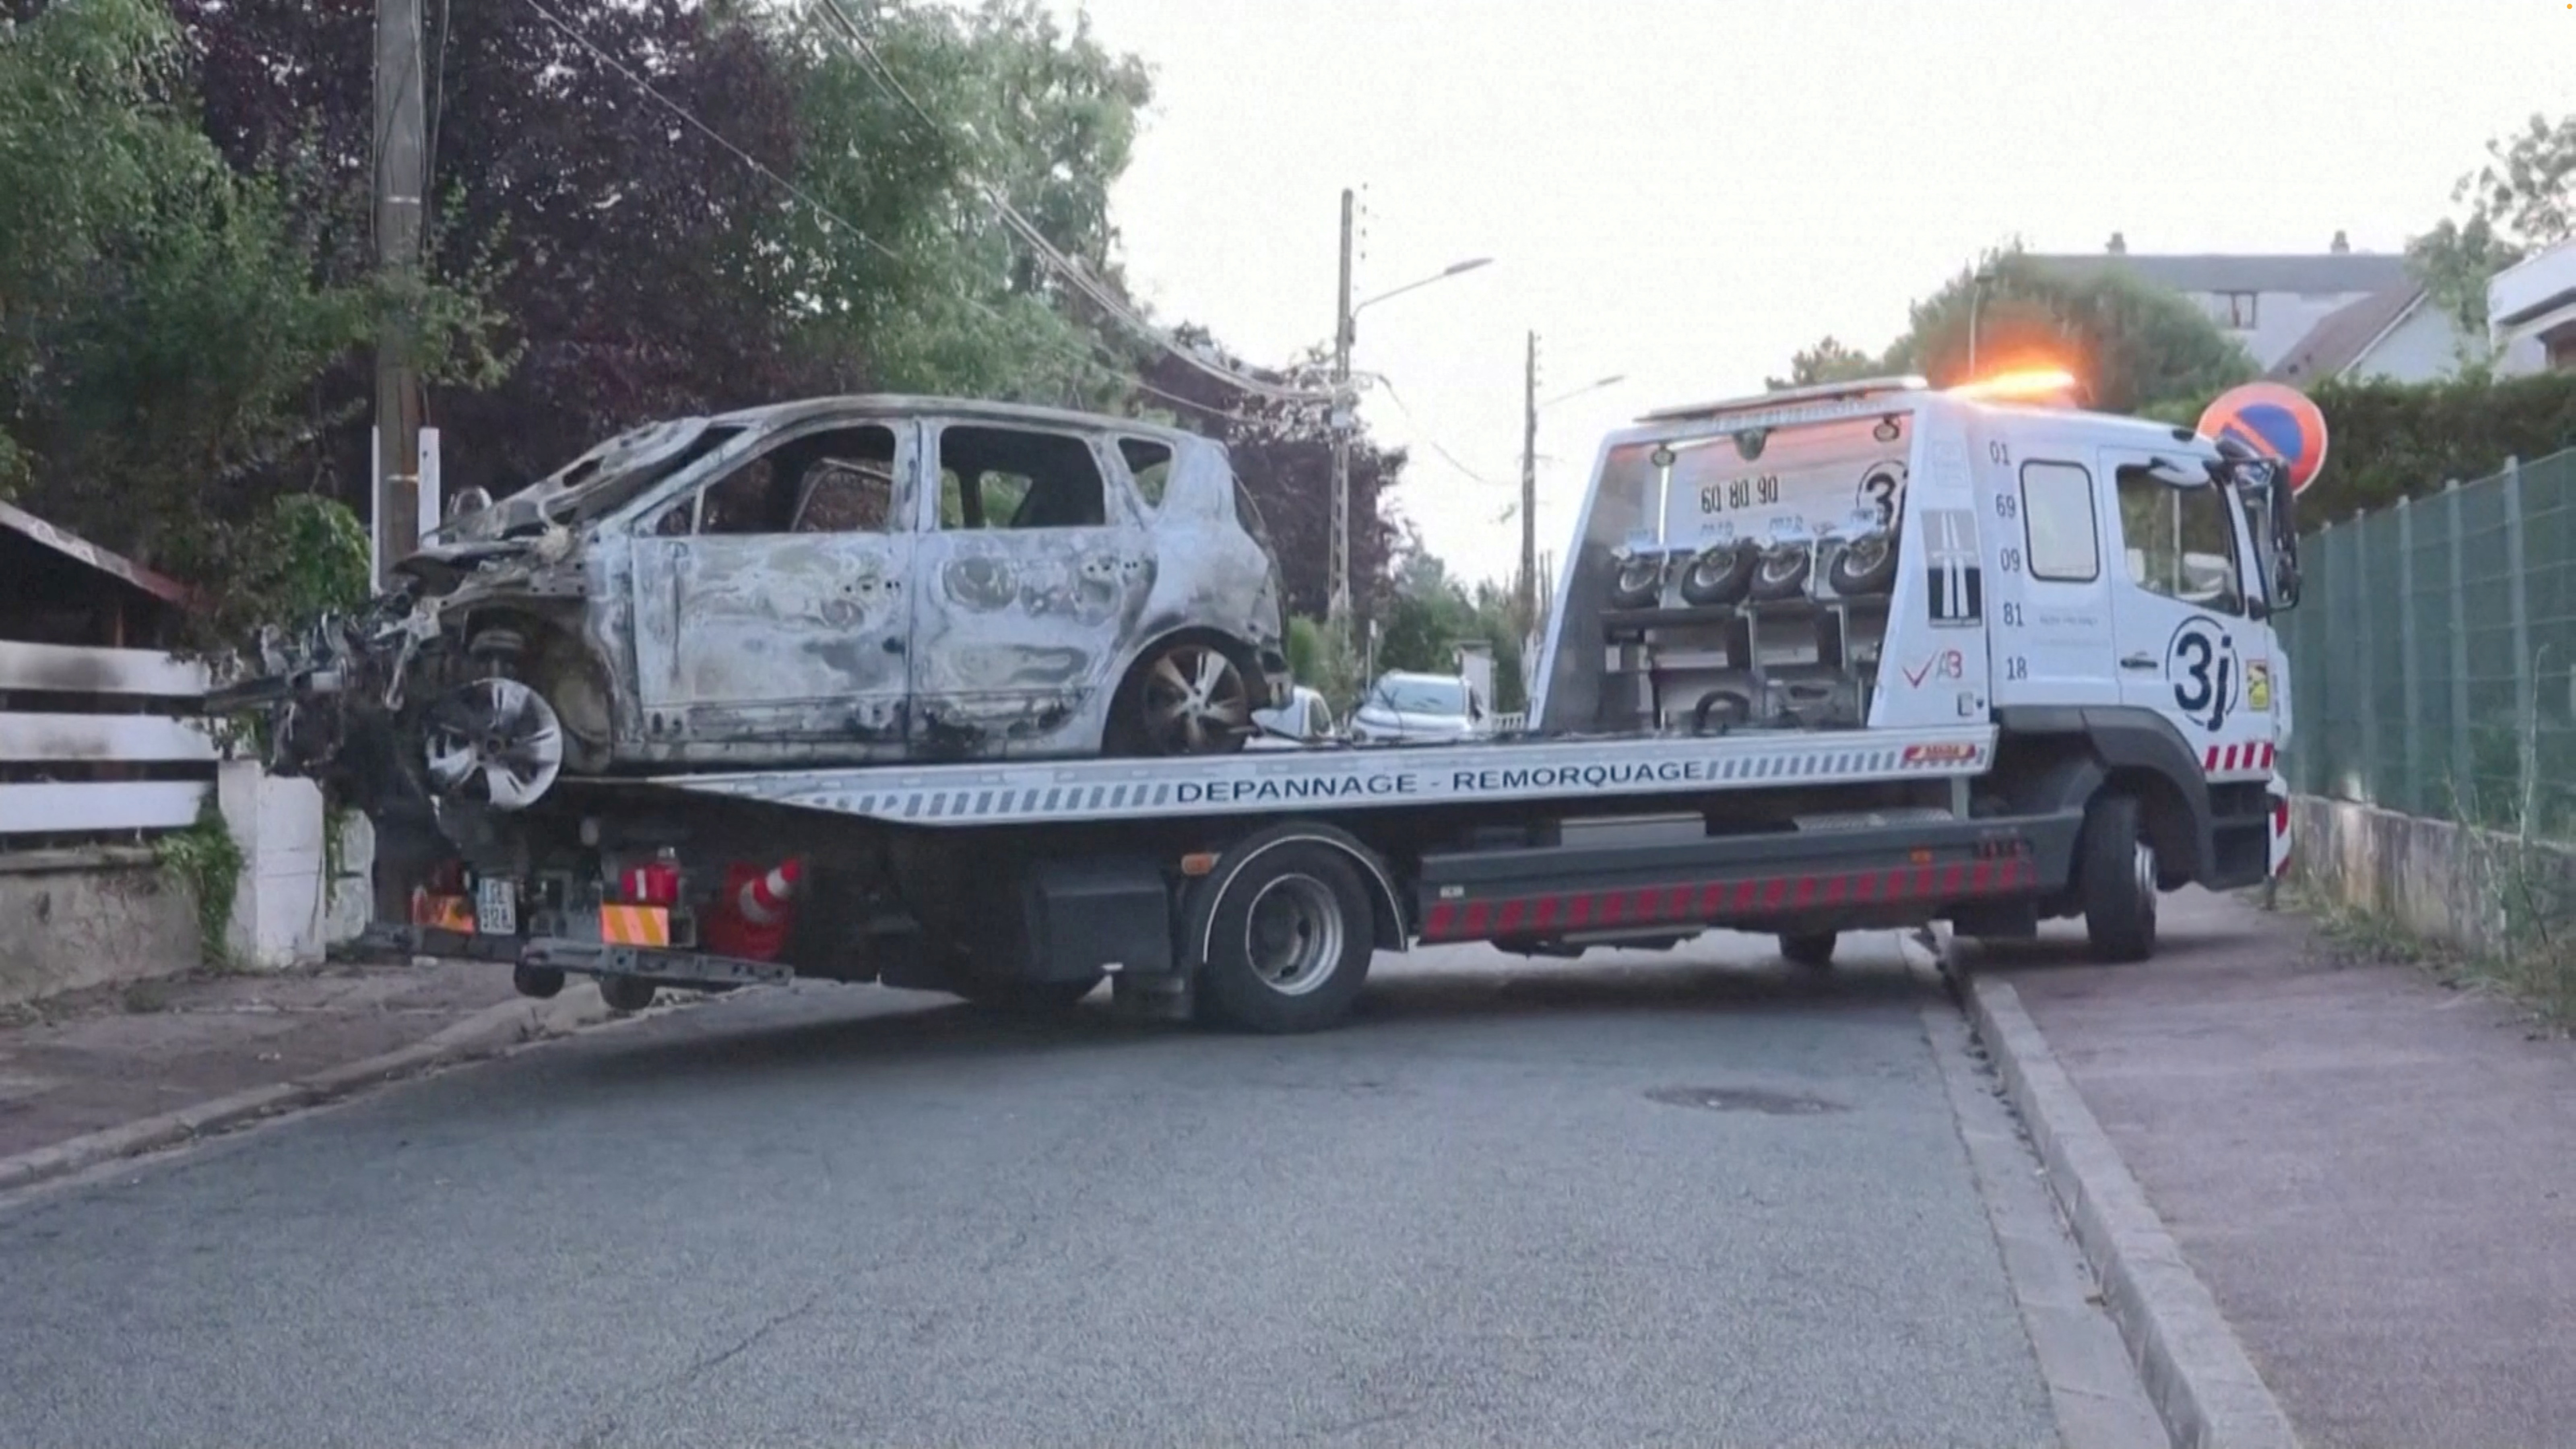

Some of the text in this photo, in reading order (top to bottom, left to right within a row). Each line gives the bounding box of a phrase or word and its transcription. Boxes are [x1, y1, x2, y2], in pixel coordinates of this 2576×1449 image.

[1990, 440, 2011, 465] 01
[1701, 476, 1778, 514] 60 80 90
[1996, 493, 2016, 518] 69
[2000, 547, 2021, 572] 09
[2003, 603, 2025, 627] 81
[2007, 656, 2028, 680] 18
[1177, 774, 1417, 803] DEPANNAGE
[1453, 761, 1702, 791] REMORQUAGE
